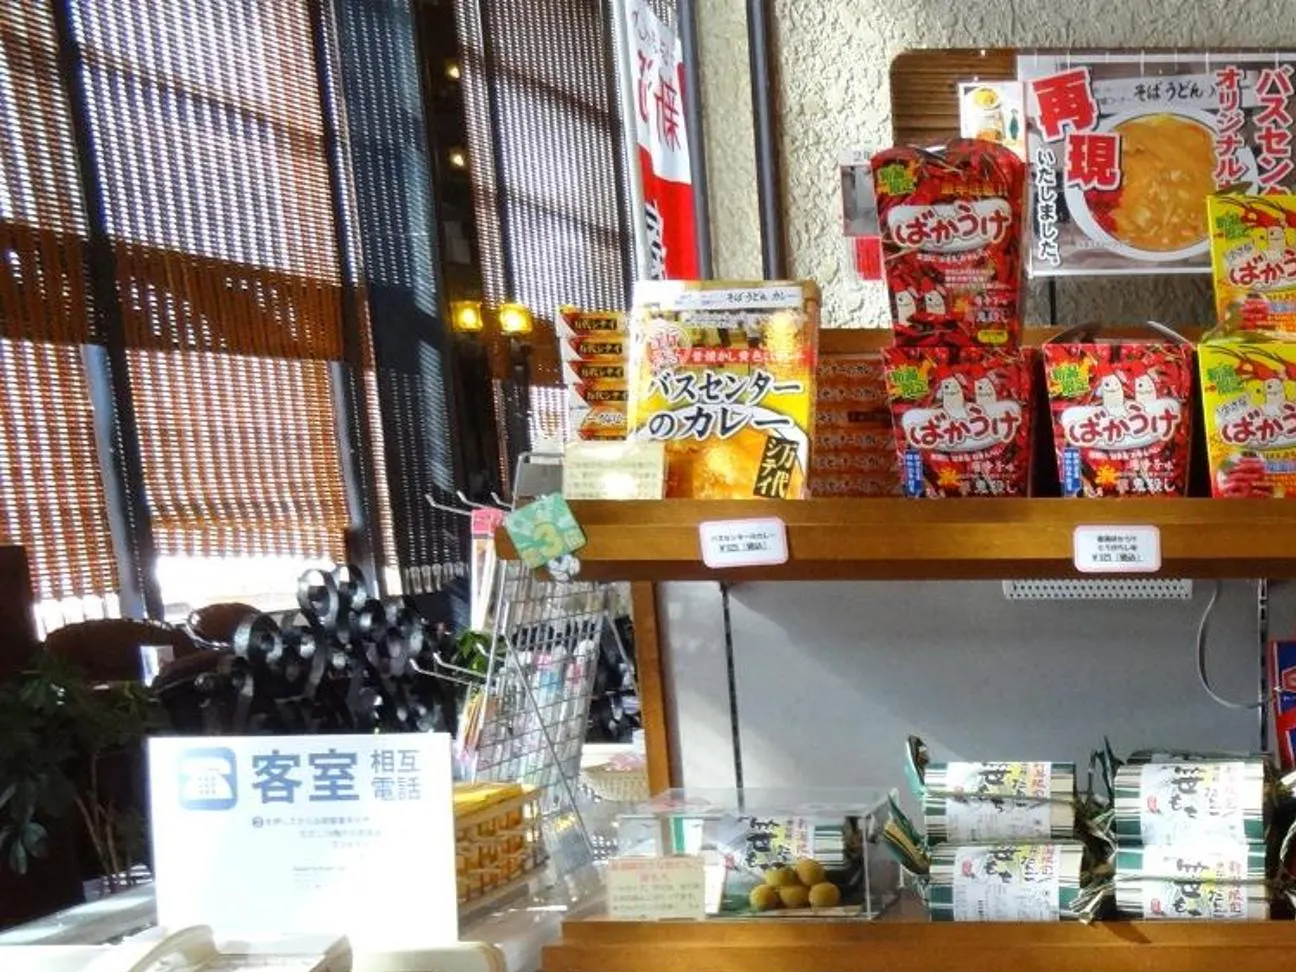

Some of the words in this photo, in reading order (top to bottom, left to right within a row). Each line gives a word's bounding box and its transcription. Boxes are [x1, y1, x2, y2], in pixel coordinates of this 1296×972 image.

[1033, 69, 1123, 191] 再現
[895, 203, 1012, 244] ばかうけ
[651, 371, 803, 402] バスセンター
[650, 406, 793, 438] のカレー
[910, 405, 1021, 446] ばかうけ
[1069, 404, 1180, 445] ばかうけ
[251, 748, 360, 804] 客室
[370, 748, 421, 775] 相互
[371, 776, 421, 801] 電話
